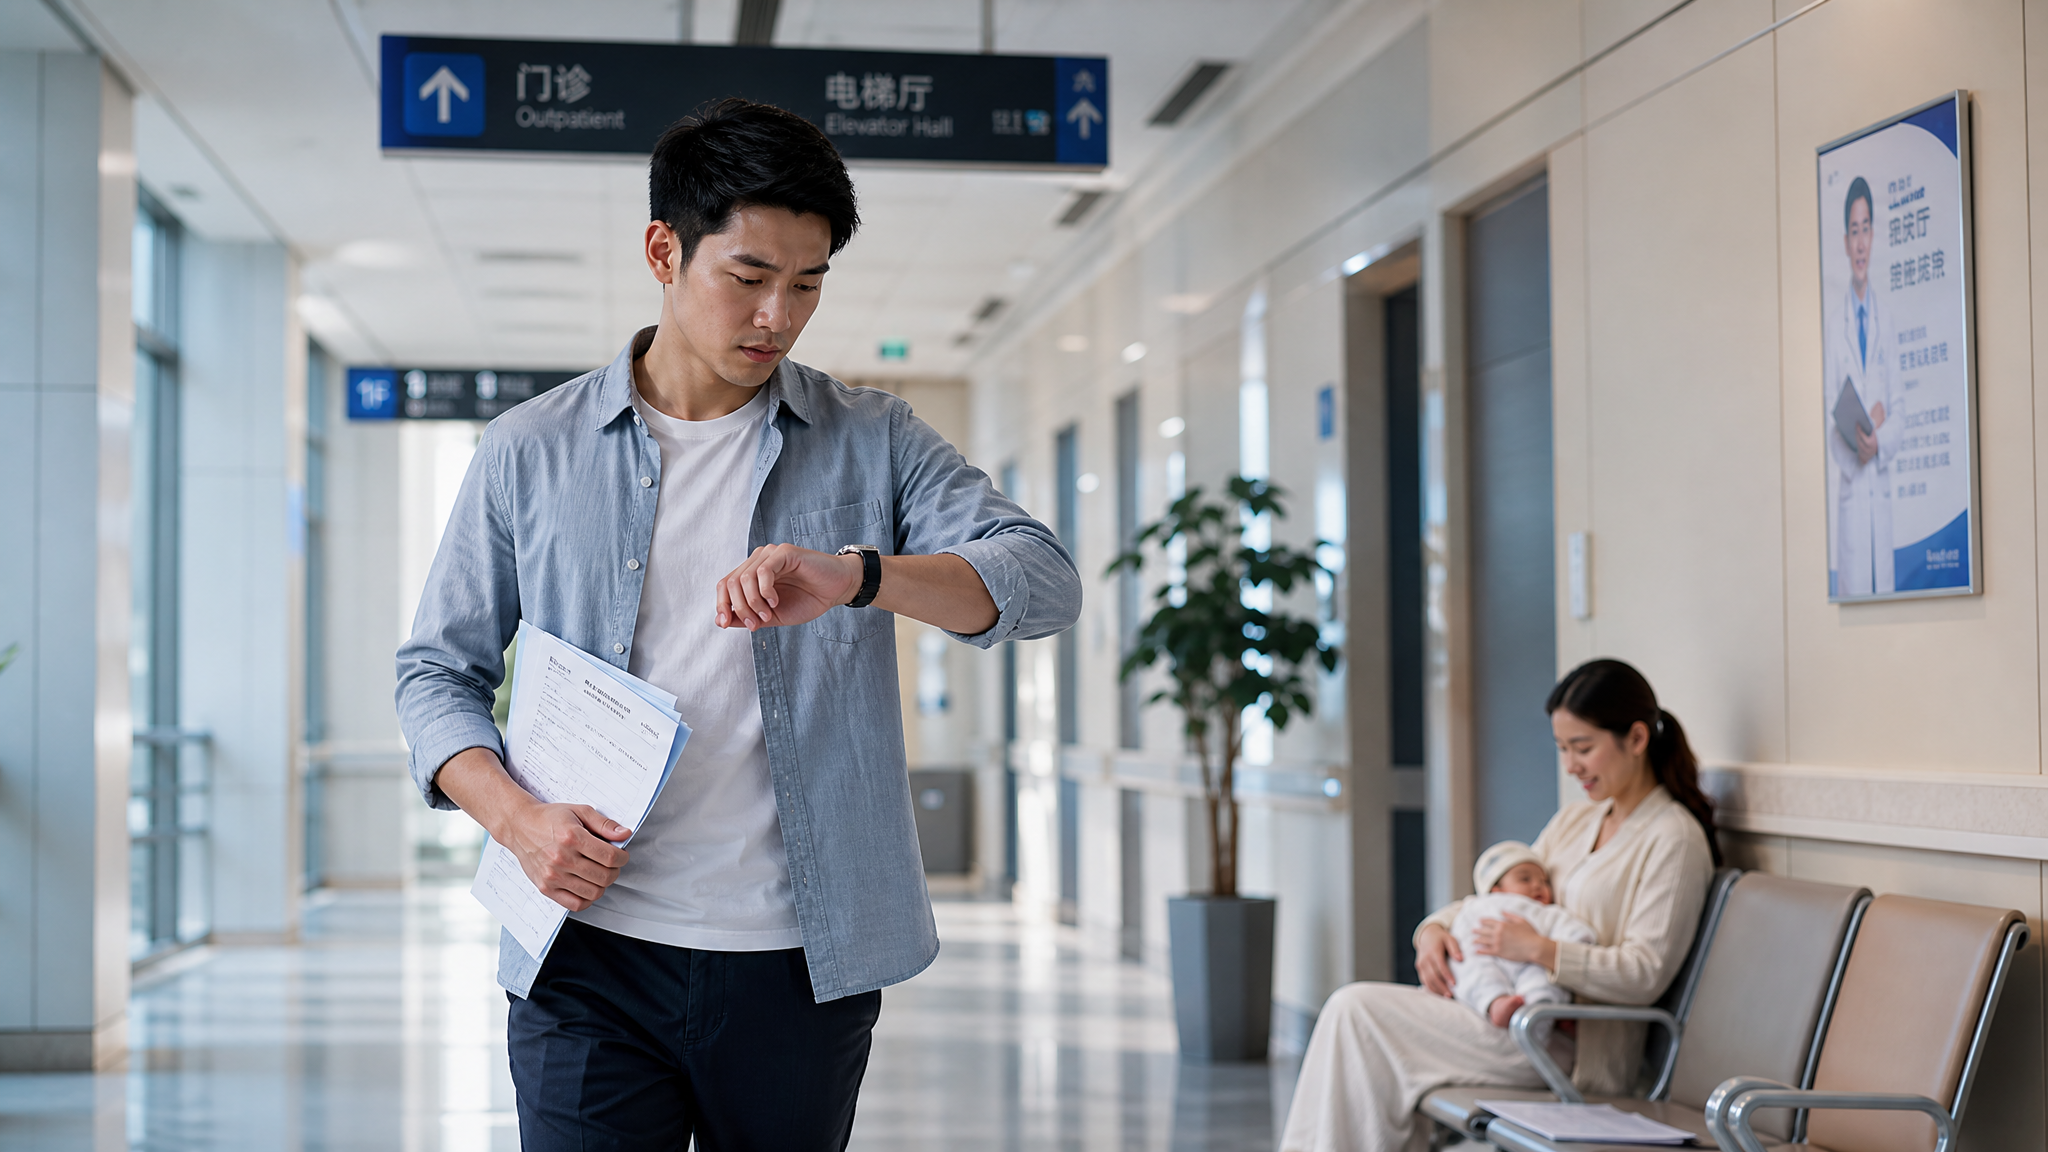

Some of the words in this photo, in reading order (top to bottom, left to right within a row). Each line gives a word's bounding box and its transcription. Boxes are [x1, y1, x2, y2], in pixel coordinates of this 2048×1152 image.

[517, 63, 592, 103] 门诊
[826, 71, 933, 111] 电梯厅
[515, 105, 625, 131] Outpatient
[825, 113, 909, 136] Elevator
[913, 116, 953, 137] Hall
